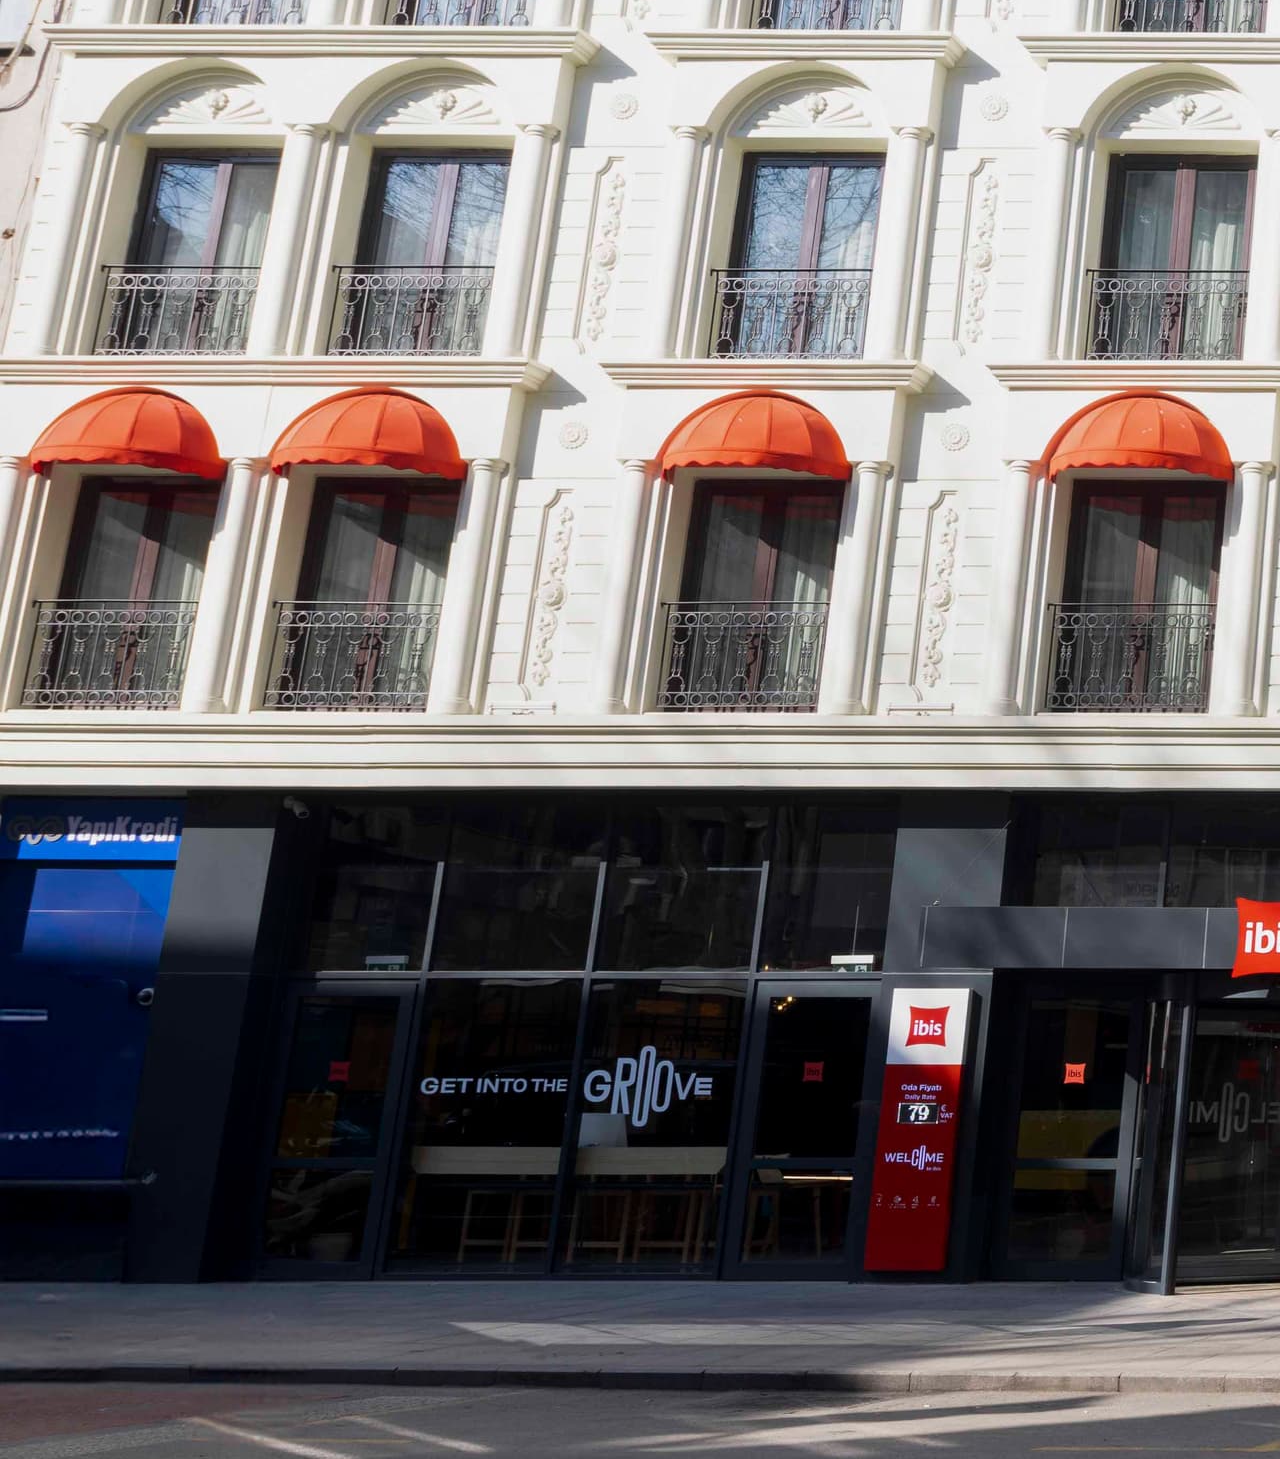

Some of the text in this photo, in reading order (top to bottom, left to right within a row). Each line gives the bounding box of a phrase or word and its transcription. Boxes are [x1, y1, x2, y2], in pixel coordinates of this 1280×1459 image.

[913, 1019, 943, 1036] ibis
[420, 1045, 714, 1128] GET INTO THE GROOVE
[901, 1083, 918, 1092] Oda
[904, 1093, 921, 1101] Daily
[908, 1104, 930, 1122] 79
[940, 1112, 954, 1120] VAT
[884, 1144, 945, 1171] WELCOME
